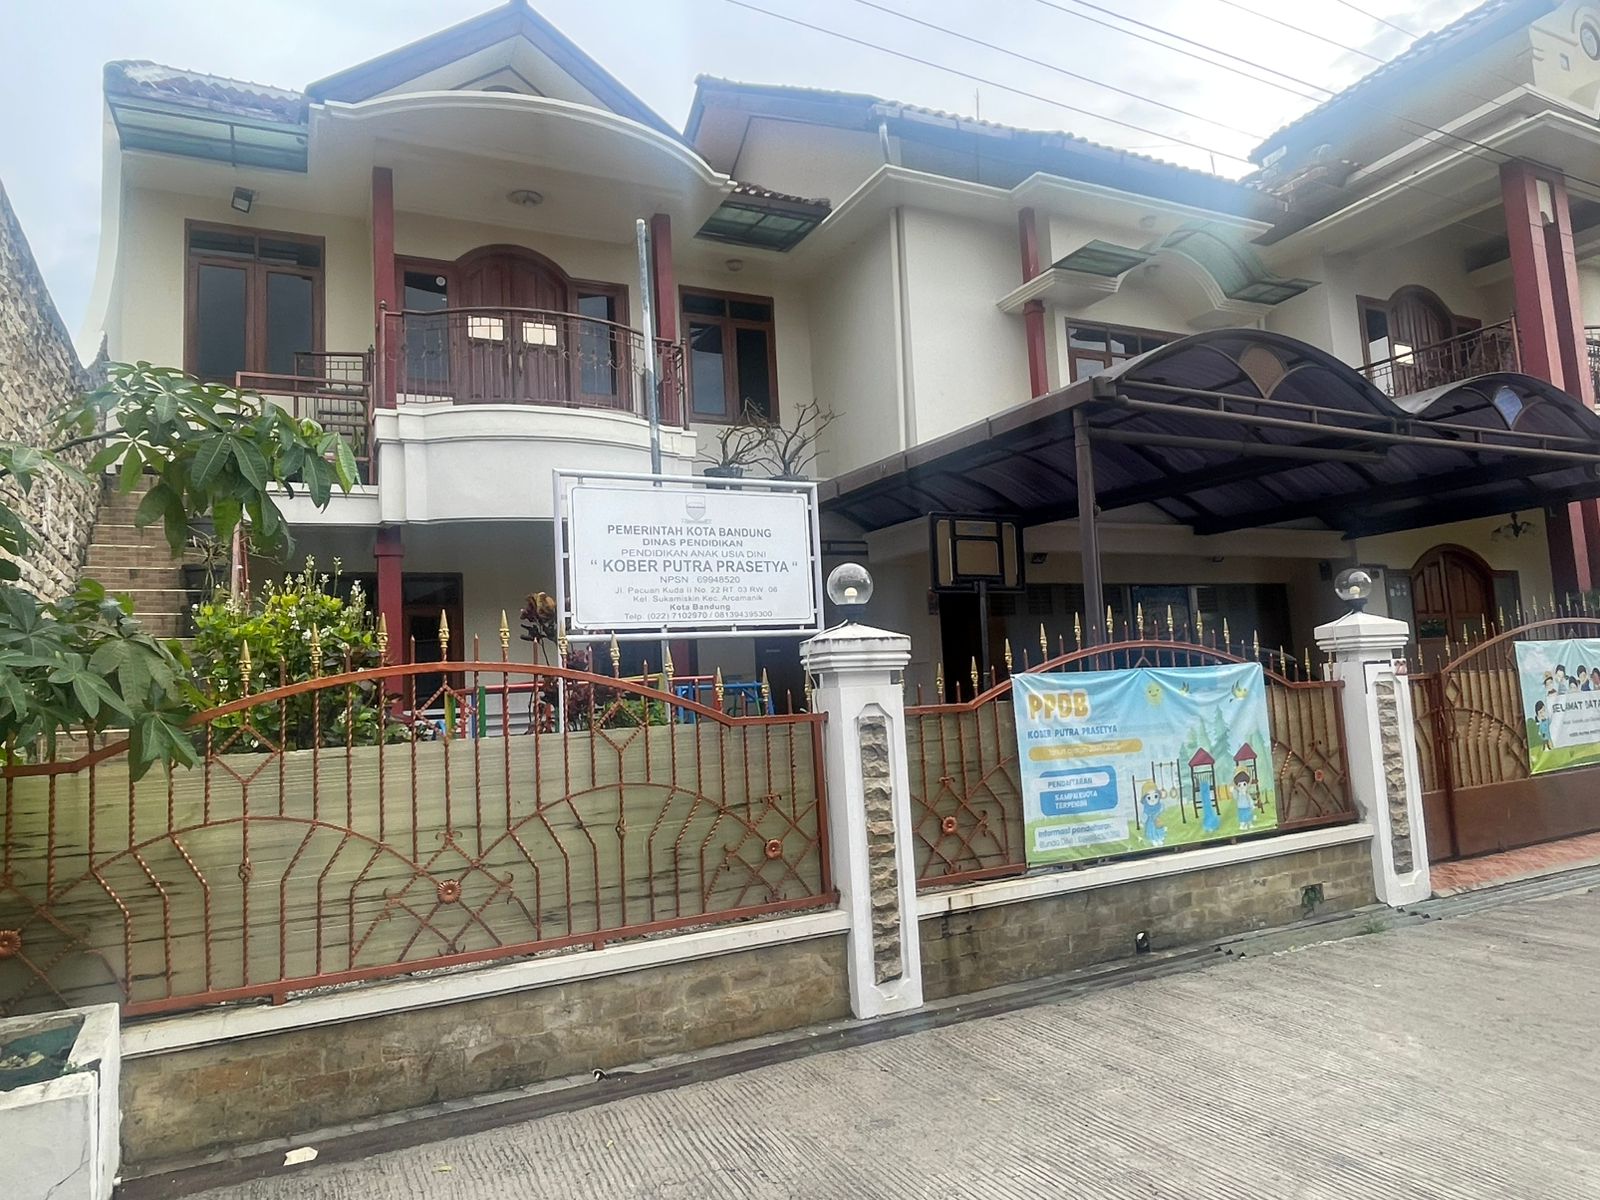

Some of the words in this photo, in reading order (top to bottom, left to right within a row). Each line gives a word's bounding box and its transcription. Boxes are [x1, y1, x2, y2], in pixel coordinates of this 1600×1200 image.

[607, 524, 683, 536] PEMERINTAH
[686, 526, 716, 537] KOTA
[719, 527, 772, 538] BANDUNG
[642, 538, 676, 546] DINAS
[680, 538, 743, 547] PENDIDIKAN
[621, 548, 688, 557] PENDIDIKAN
[691, 550, 718, 558] ANAK
[721, 550, 745, 558] USIA
[746, 550, 767, 558] DINI
[603, 559, 658, 572] KOBER
[663, 559, 713, 573] PUTRA
[716, 560, 789, 573] PRASETYA
[660, 575, 689, 583] NPSN
[696, 575, 740, 583] 69948520
[652, 594, 700, 602] Sukamiskin
[669, 603, 690, 611] Kota
[692, 603, 731, 611] Bandung
[647, 612, 669, 620] (022)
[672, 611, 708, 619] 7102970
[1028, 691, 1089, 720] PPDB
[1551, 700, 1583, 713] SELAMAT
[1054, 727, 1080, 737] PUTRA
[1082, 724, 1118, 736] PRASETYA
